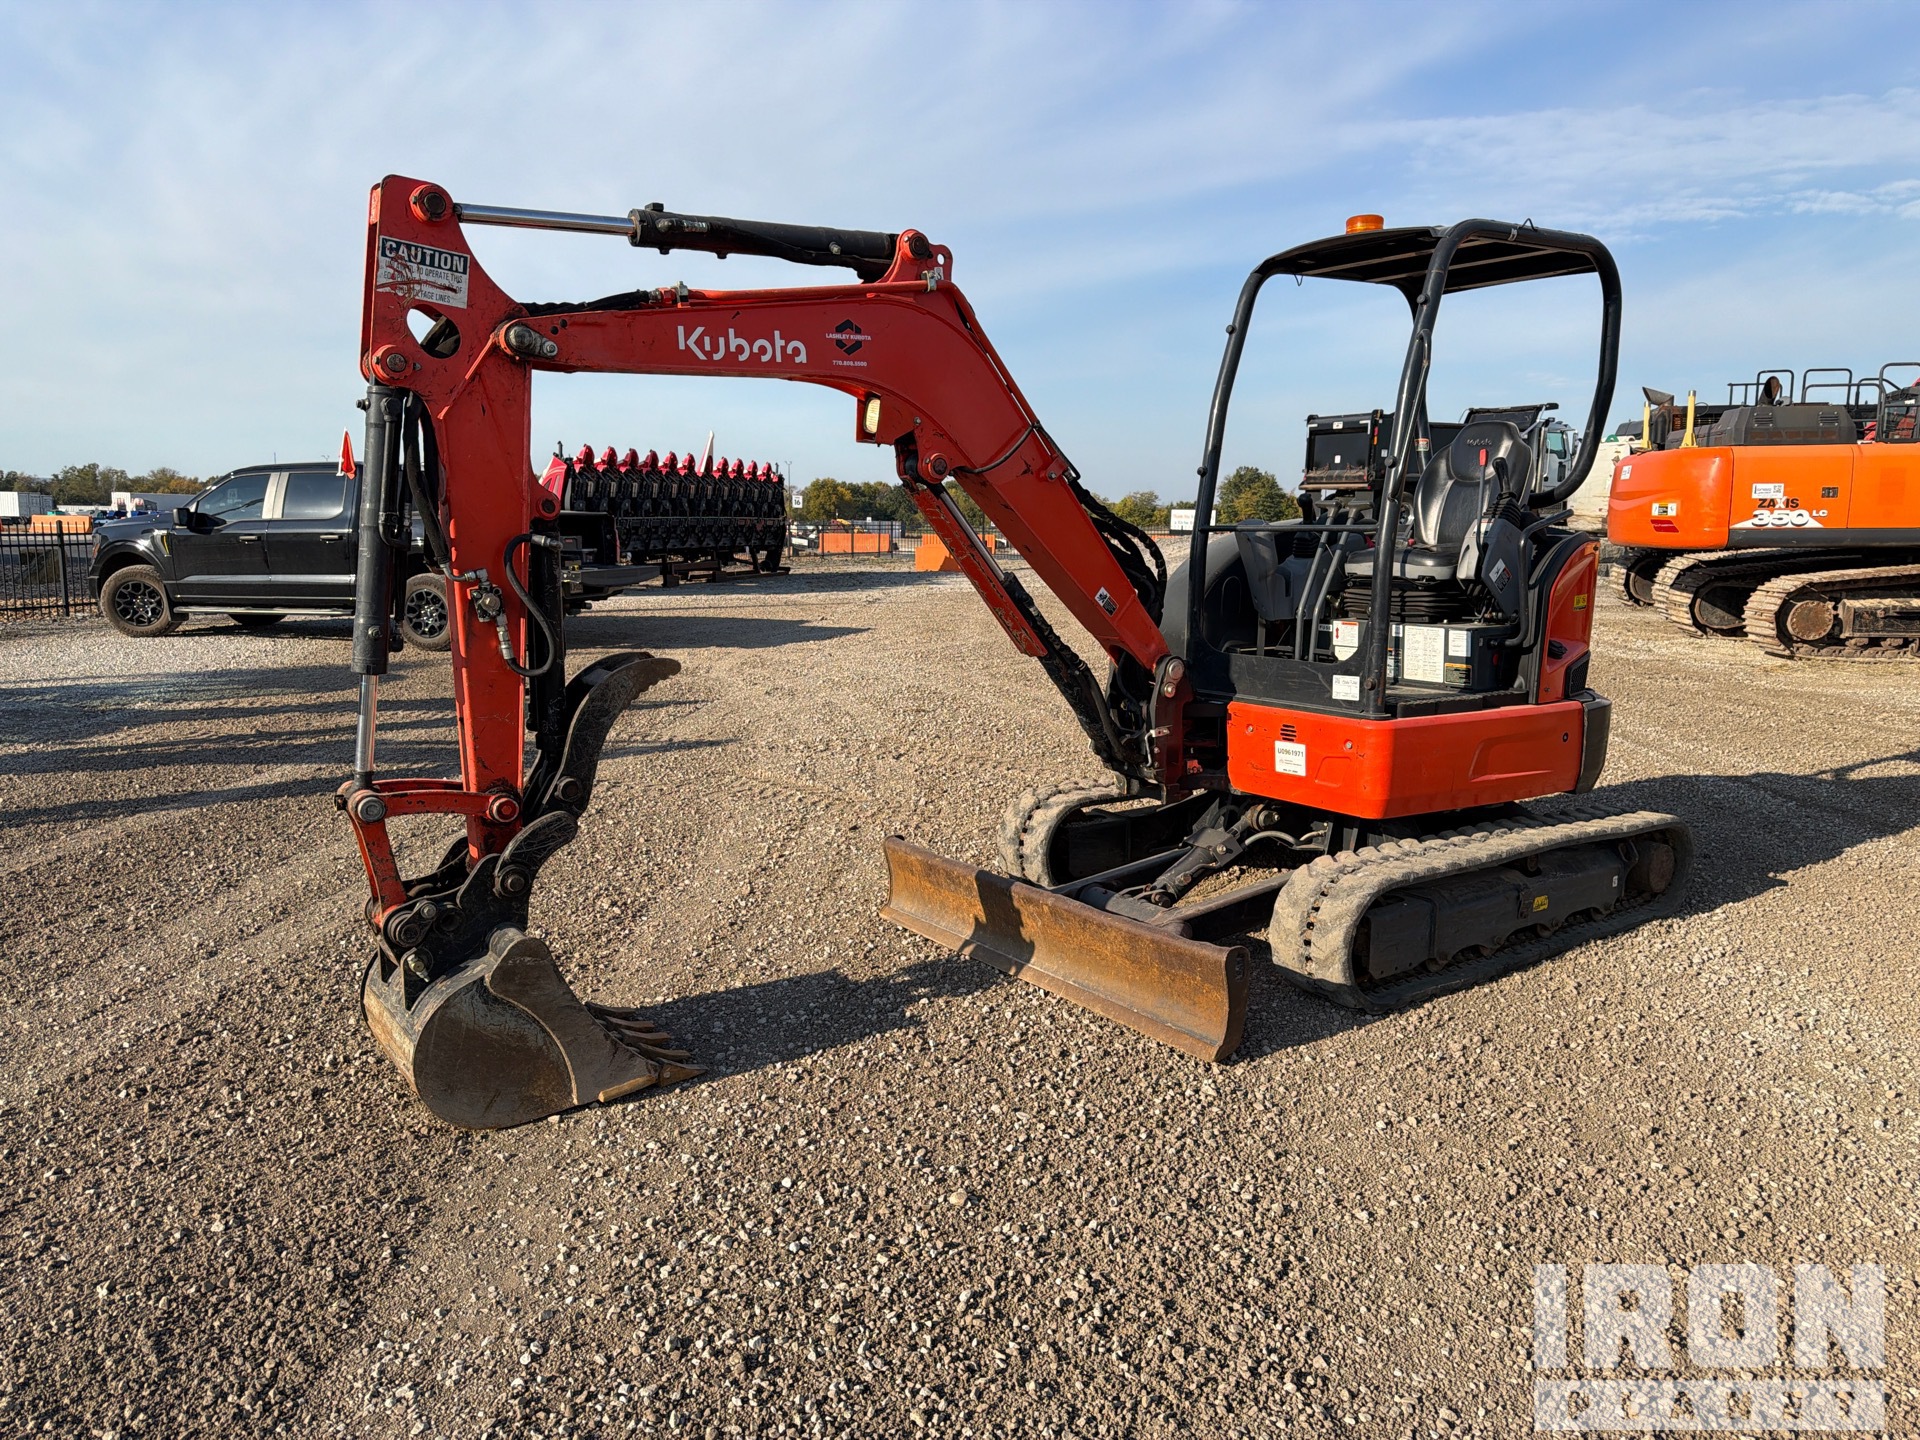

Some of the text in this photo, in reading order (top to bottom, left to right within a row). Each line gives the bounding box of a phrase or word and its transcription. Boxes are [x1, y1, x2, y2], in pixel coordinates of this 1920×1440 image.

[385, 241, 465, 273] CAUTION
[424, 268, 449, 281] OPERATE
[450, 272, 463, 283] THIS
[435, 293, 451, 303] LINES
[825, 332, 850, 340] LASHLEY
[677, 325, 808, 364] Kubota
[1758, 496, 1799, 508] ZAXIS
[1752, 509, 1809, 527] 350
